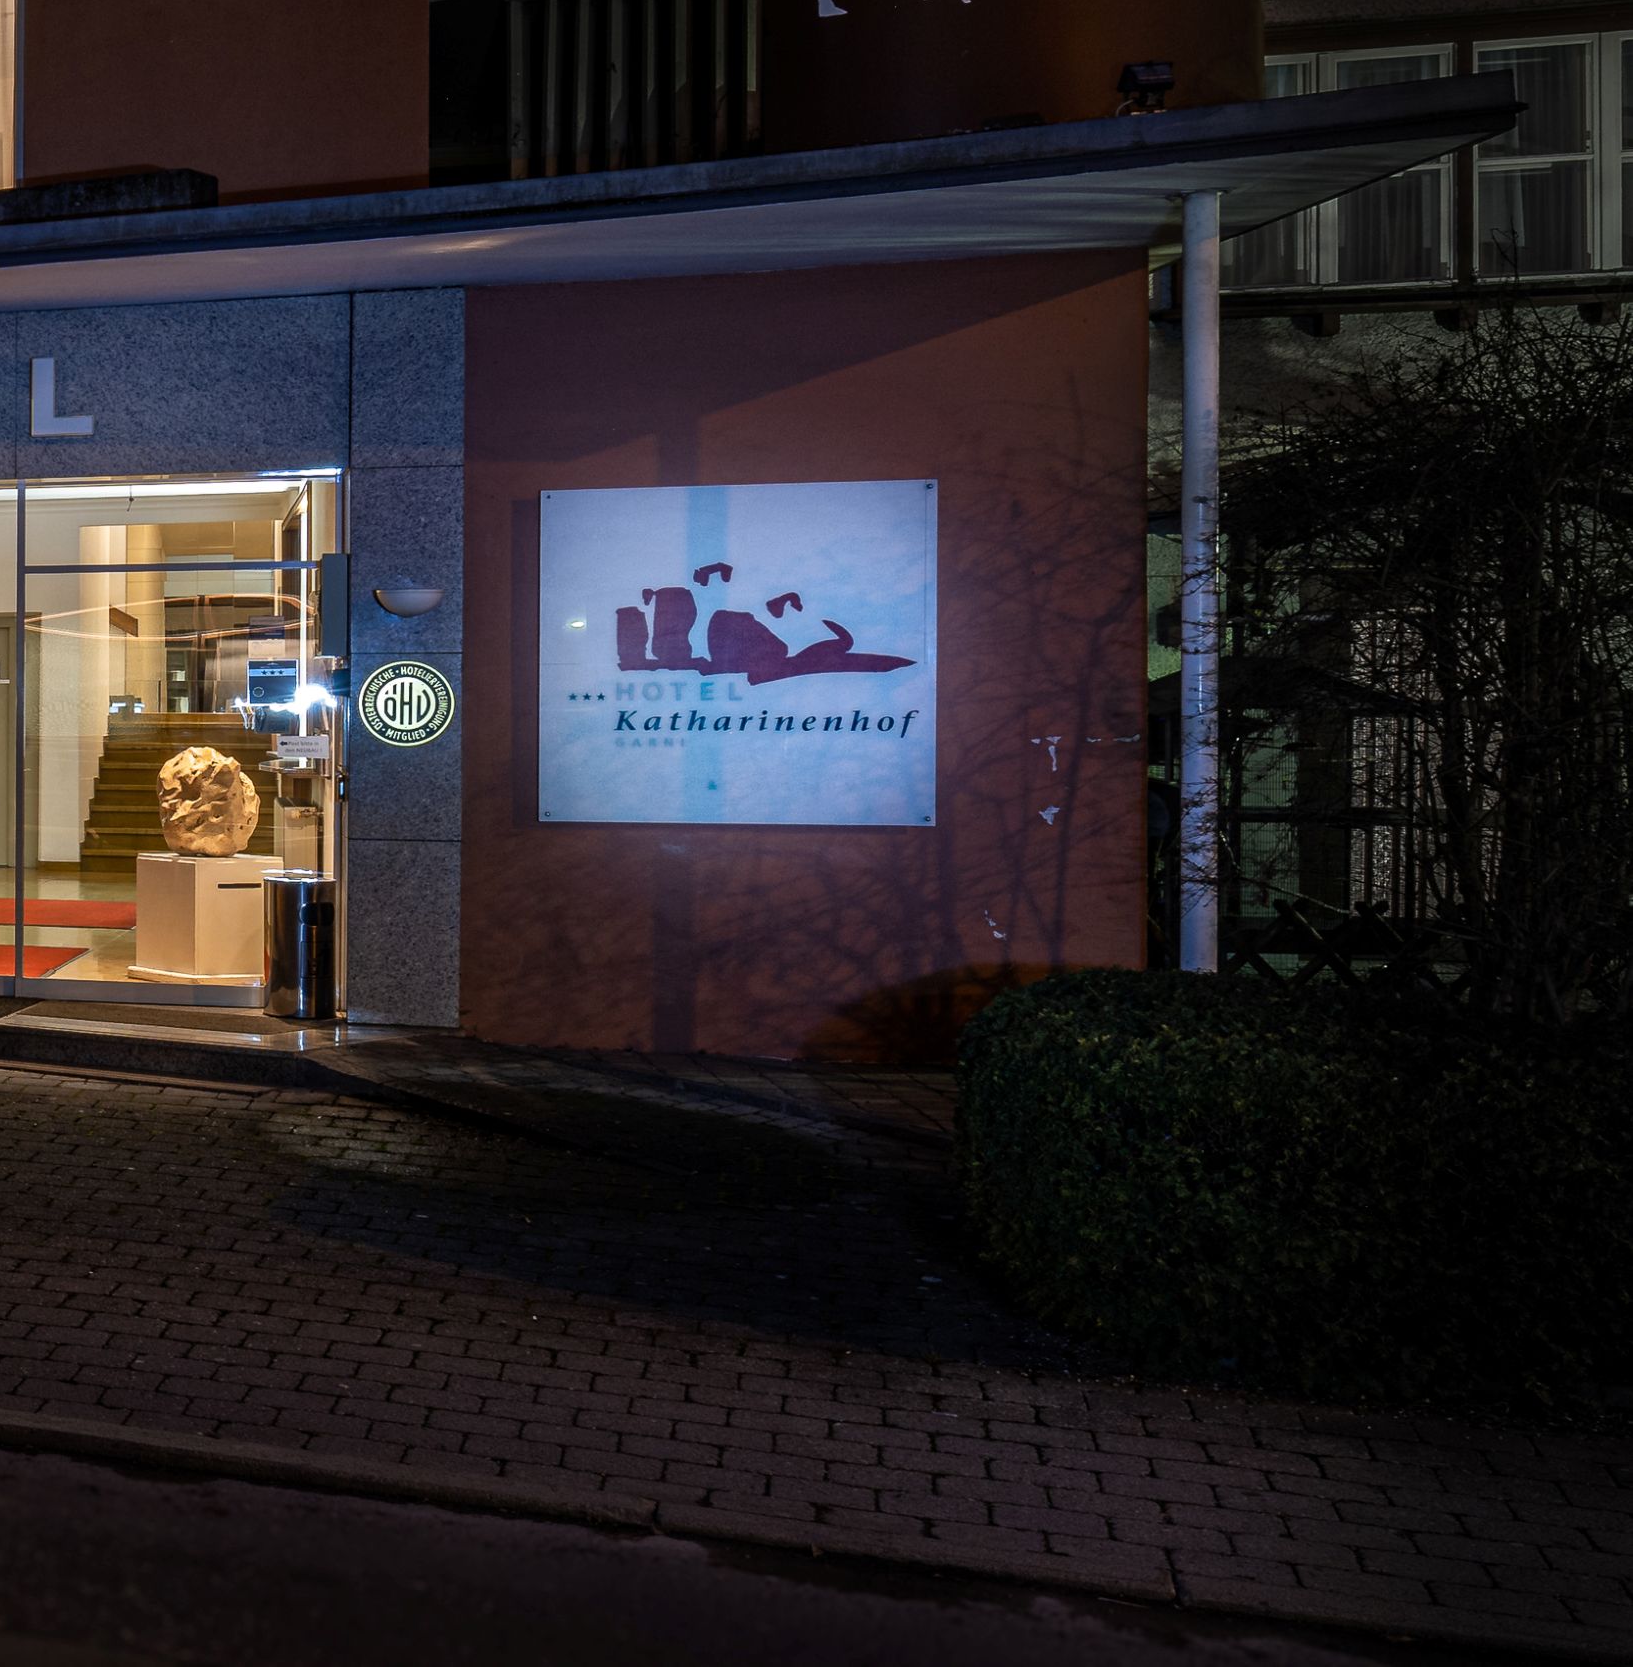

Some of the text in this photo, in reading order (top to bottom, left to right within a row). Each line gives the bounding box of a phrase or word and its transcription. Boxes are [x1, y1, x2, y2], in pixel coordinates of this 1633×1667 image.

[364, 668, 396, 731] ÖSTERREICHISCHE
[400, 665, 449, 731] HOTELIERVEREINIGUNG
[615, 682, 743, 702] HOTEL
[385, 728, 426, 741] MITGLIED
[613, 710, 920, 739] Katharinenhof
[615, 738, 687, 748] GARNI
